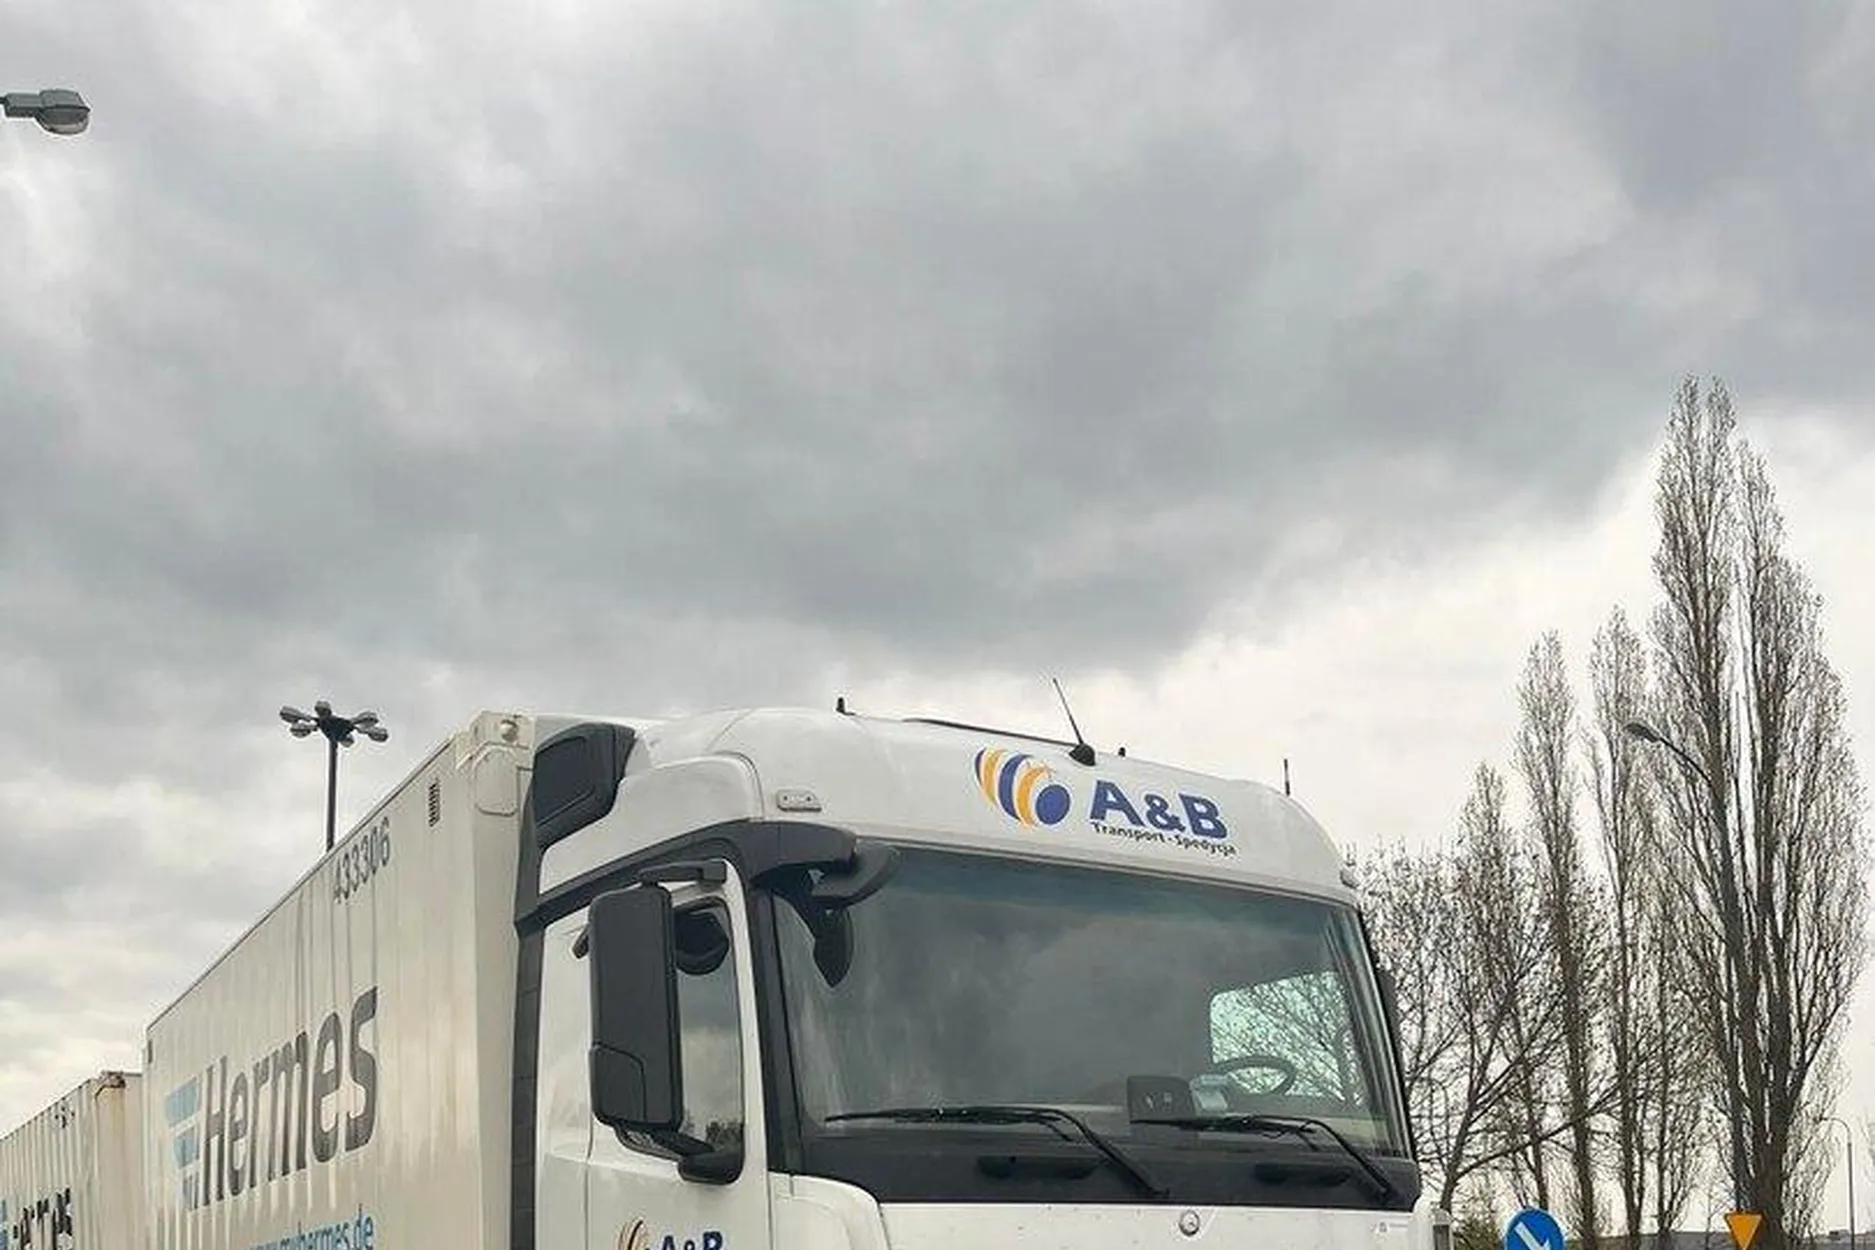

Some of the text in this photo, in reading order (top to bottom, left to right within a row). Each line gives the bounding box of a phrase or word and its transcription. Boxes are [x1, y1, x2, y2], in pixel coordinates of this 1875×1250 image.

[1090, 779, 1228, 840] A&B
[1090, 821, 1167, 842] Transport
[1174, 833, 1237, 857] Spedycja
[333, 816, 391, 905] 433306
[202, 985, 378, 1207] Hermes
